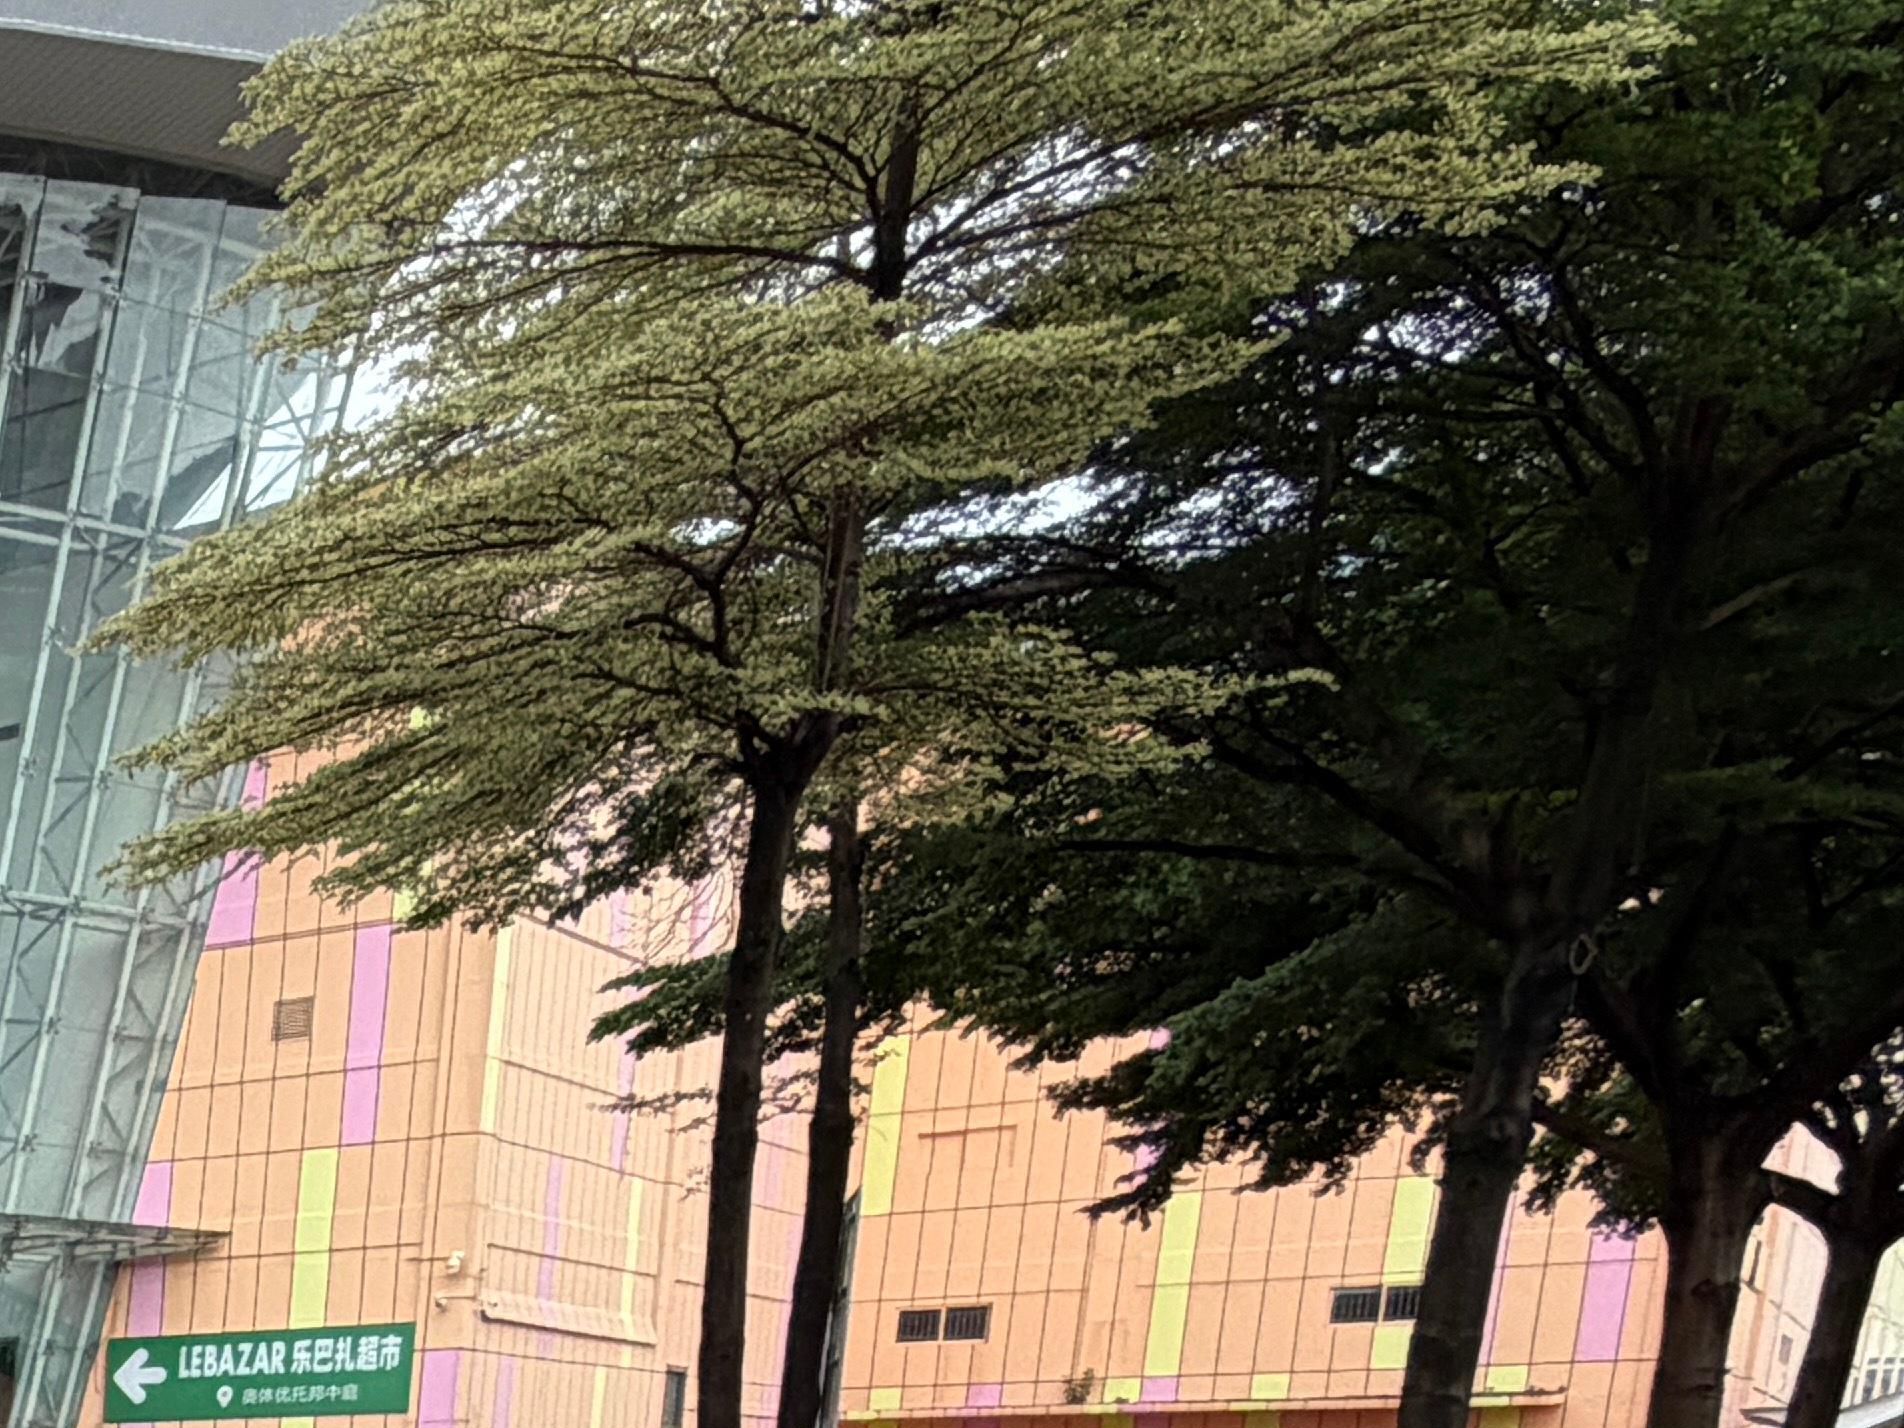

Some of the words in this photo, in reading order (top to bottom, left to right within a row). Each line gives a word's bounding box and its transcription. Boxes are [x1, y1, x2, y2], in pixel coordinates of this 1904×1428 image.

[178, 1340, 286, 1379] LEBAZAR
[291, 1334, 403, 1374] 乐巴扎超市
